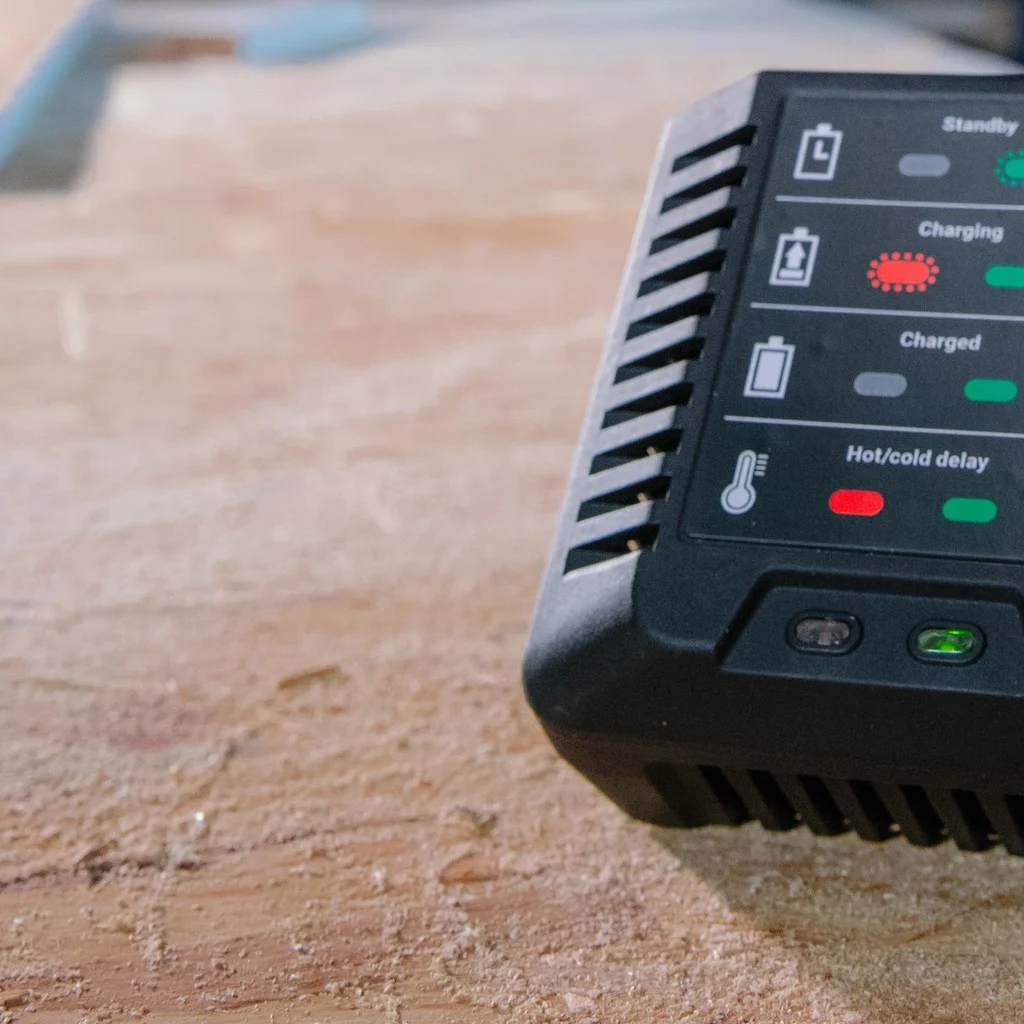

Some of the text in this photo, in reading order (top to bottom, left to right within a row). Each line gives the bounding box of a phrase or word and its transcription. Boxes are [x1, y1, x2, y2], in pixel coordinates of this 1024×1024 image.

[941, 116, 1019, 136] Standby
[918, 221, 1005, 242] Charging
[900, 331, 982, 353] Charged
[846, 446, 990, 473] Hot/cold delay
